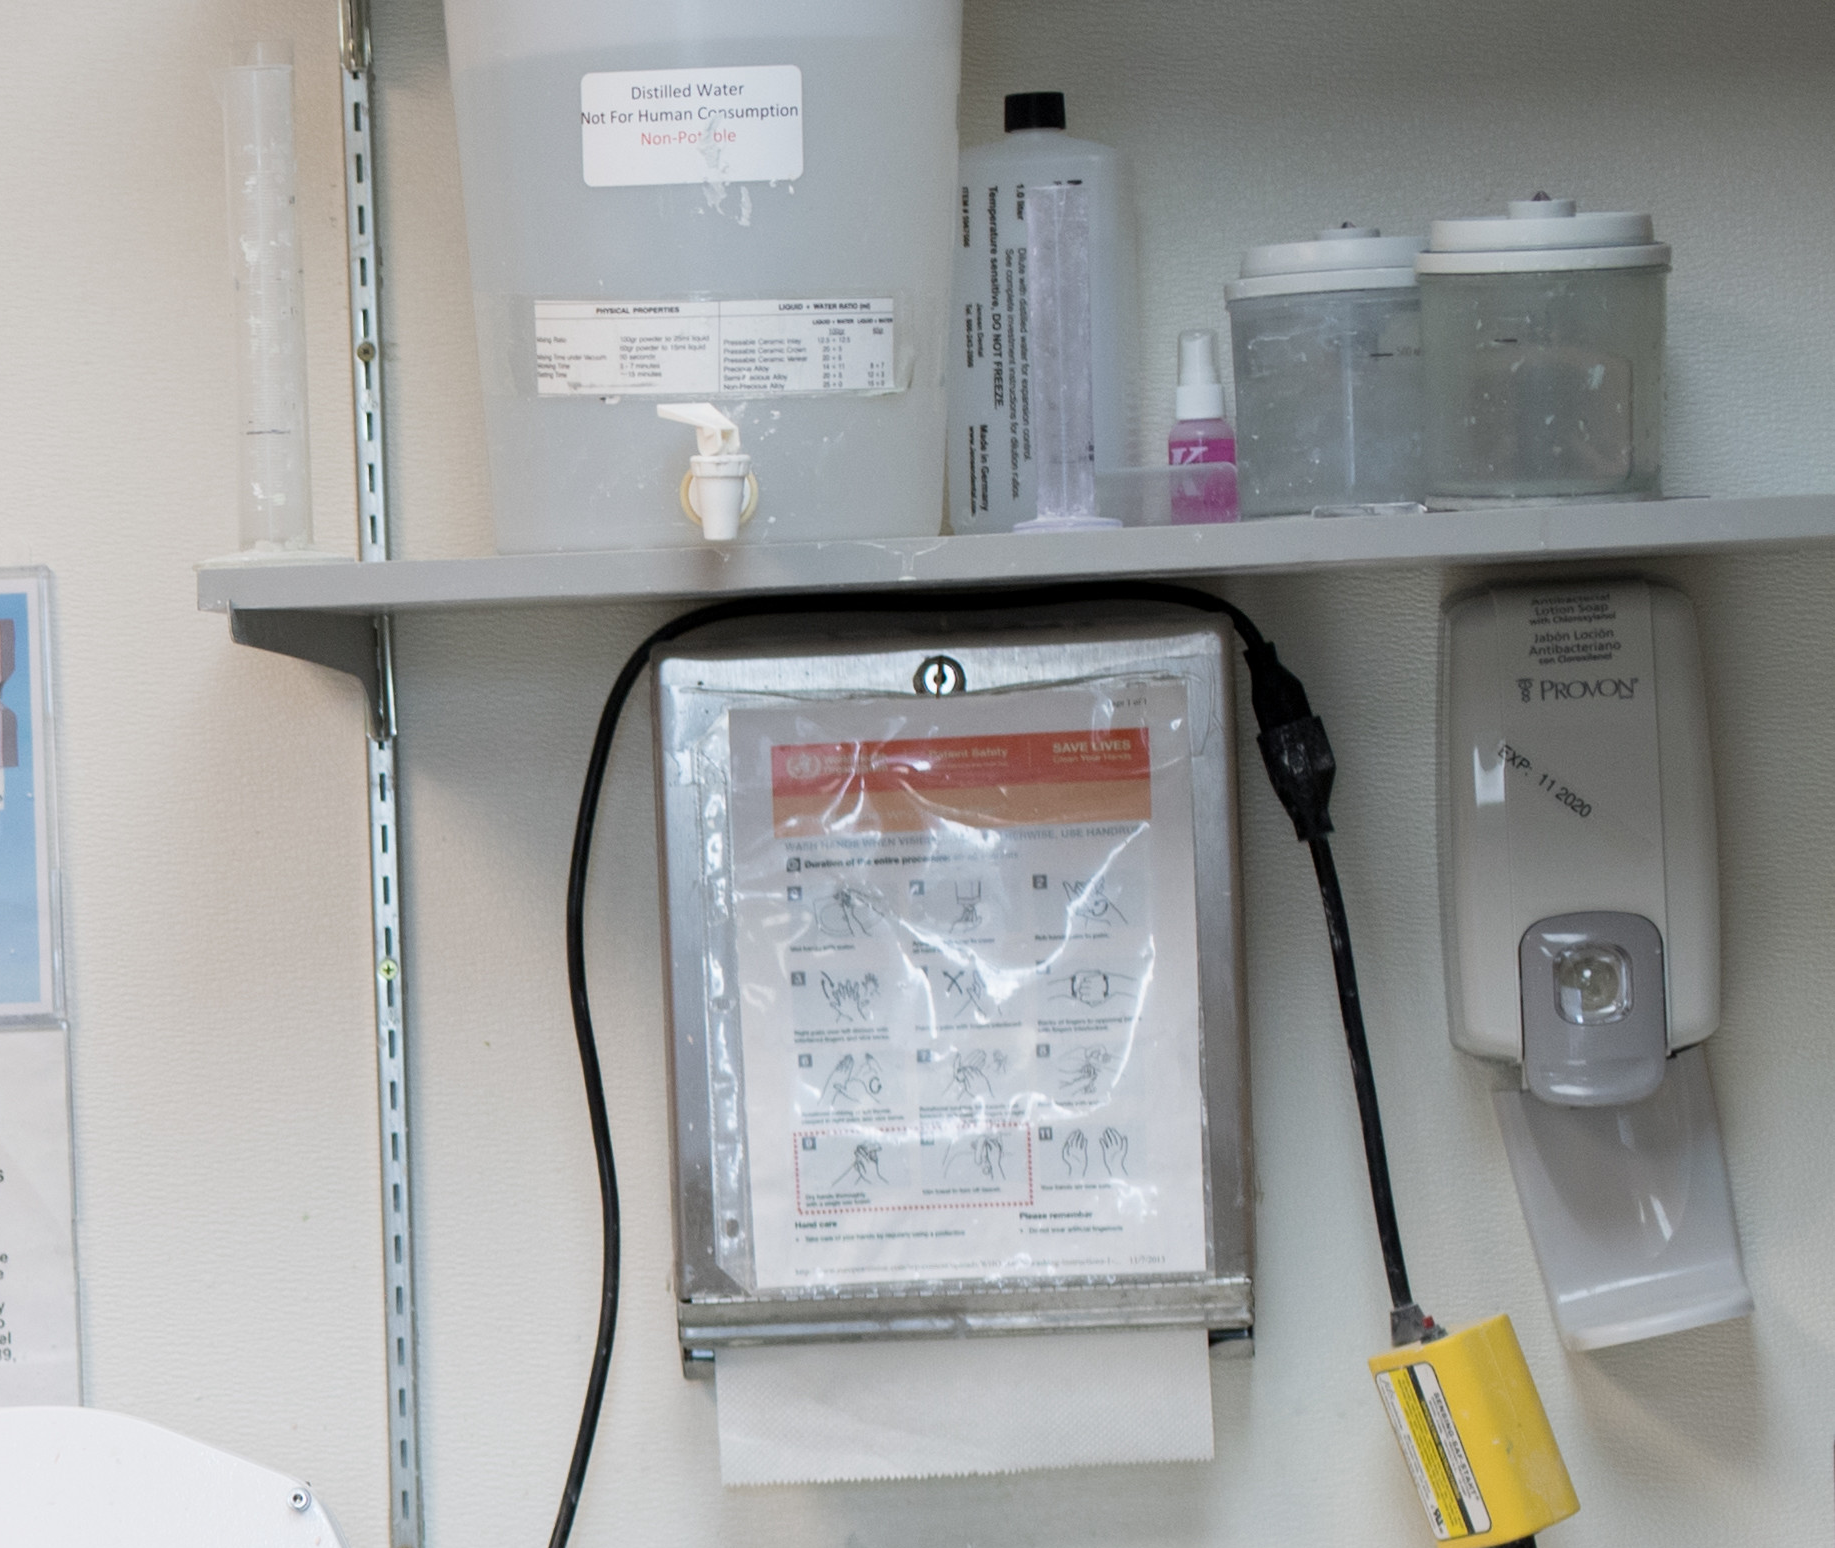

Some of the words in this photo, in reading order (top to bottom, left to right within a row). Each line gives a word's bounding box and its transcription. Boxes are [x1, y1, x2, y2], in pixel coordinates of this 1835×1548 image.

[631, 84, 691, 100] Distilled
[697, 84, 744, 97] Water
[581, 112, 606, 124] Not
[611, 110, 632, 123] For
[639, 108, 692, 122] Human
[641, 130, 736, 145] Non-Potble
[988, 186, 998, 254] Temperature
[993, 333, 1002, 359] NOT
[1535, 605, 1574, 615] Lotion
[1578, 603, 1609, 614] Soap
[1535, 631, 1570, 644] Jabón
[1574, 629, 1614, 640] Loción
[1530, 641, 1621, 656] Antibacteriano
[1053, 742, 1087, 753] SAVE
[1092, 740, 1131, 750] LIVES
[1539, 774, 1555, 791] 11
[1555, 787, 1592, 817] 2020
